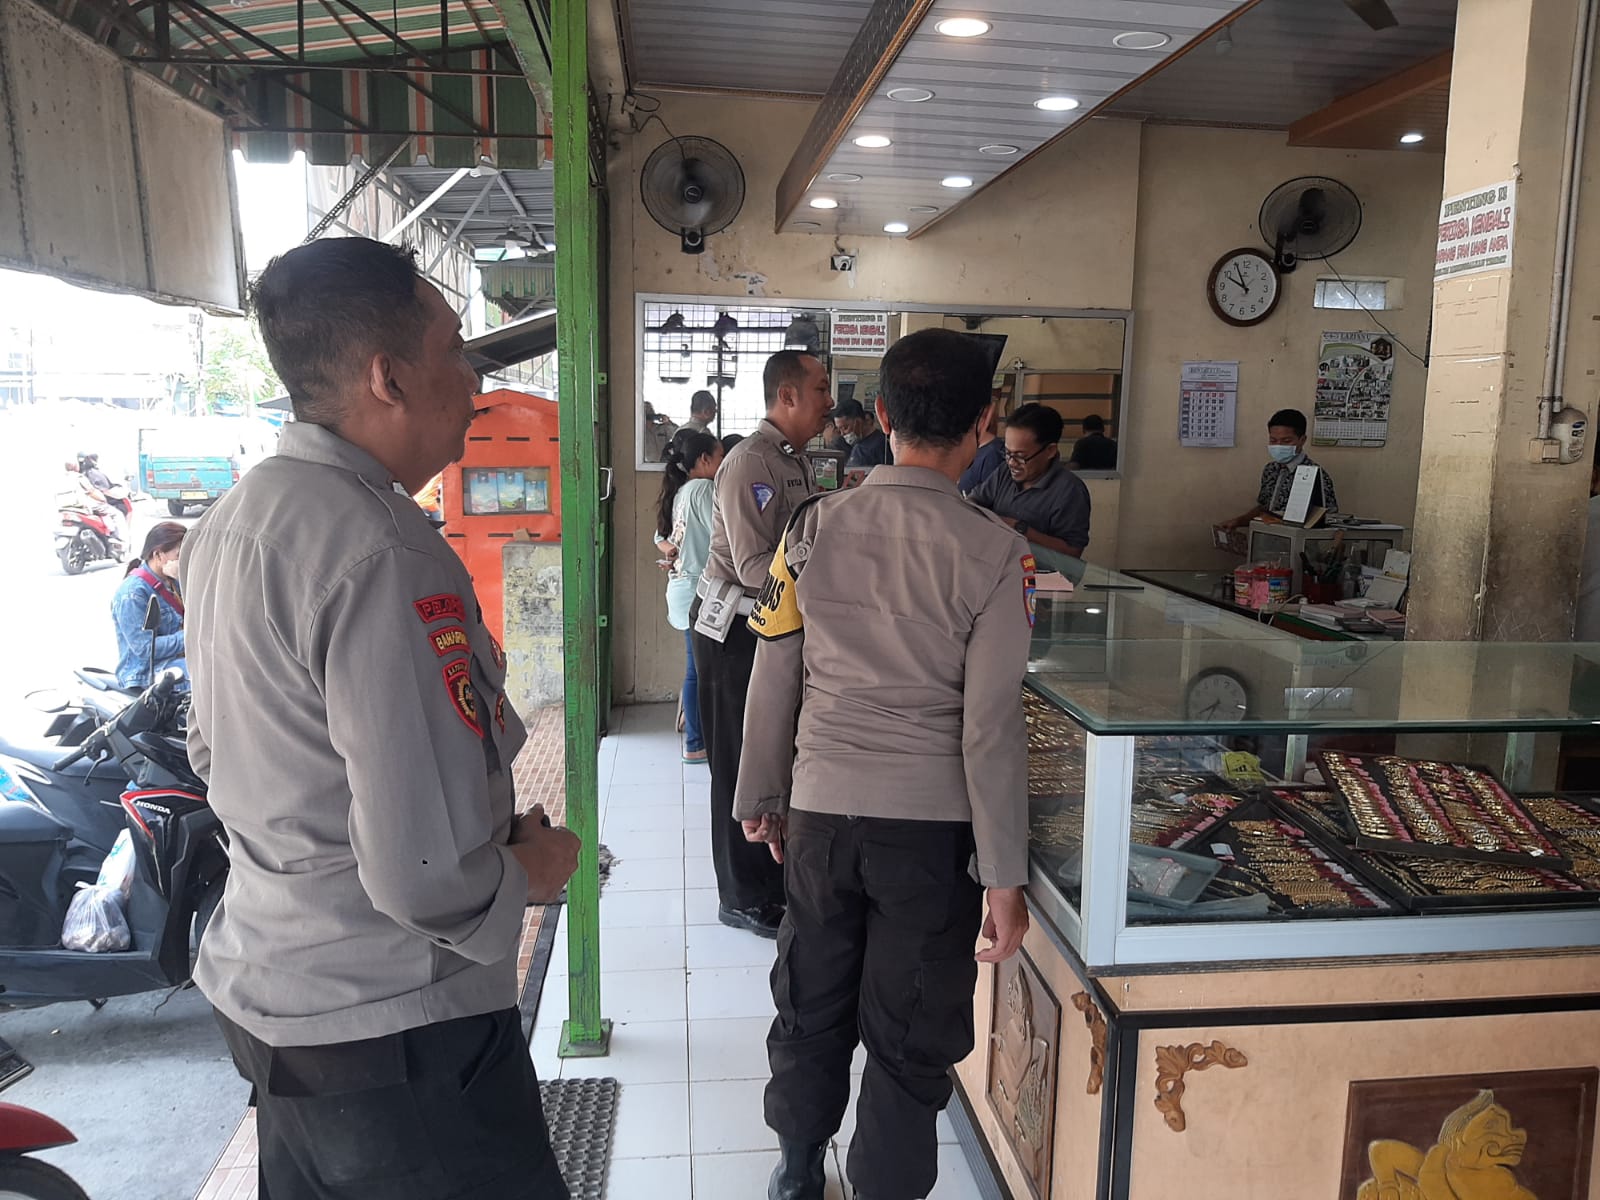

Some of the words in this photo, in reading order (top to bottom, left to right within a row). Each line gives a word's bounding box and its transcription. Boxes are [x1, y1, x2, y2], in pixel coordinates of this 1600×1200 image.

[1444, 189, 1496, 218] PENTING
[1471, 207, 1511, 236] KEMBALI
[1435, 245, 1457, 264] ARANG
[1243, 260, 1251, 269] 12
[1223, 270, 1231, 278] 10
[1260, 272, 1267, 280] 2
[1219, 282, 1225, 290] 9
[1263, 285, 1268, 293] 3
[1221, 294, 1227, 302] 8
[1229, 303, 1235, 311] 7
[1239, 307, 1245, 315] 6
[1250, 304, 1256, 312] 5
[135, 801, 171, 815] HONDA
